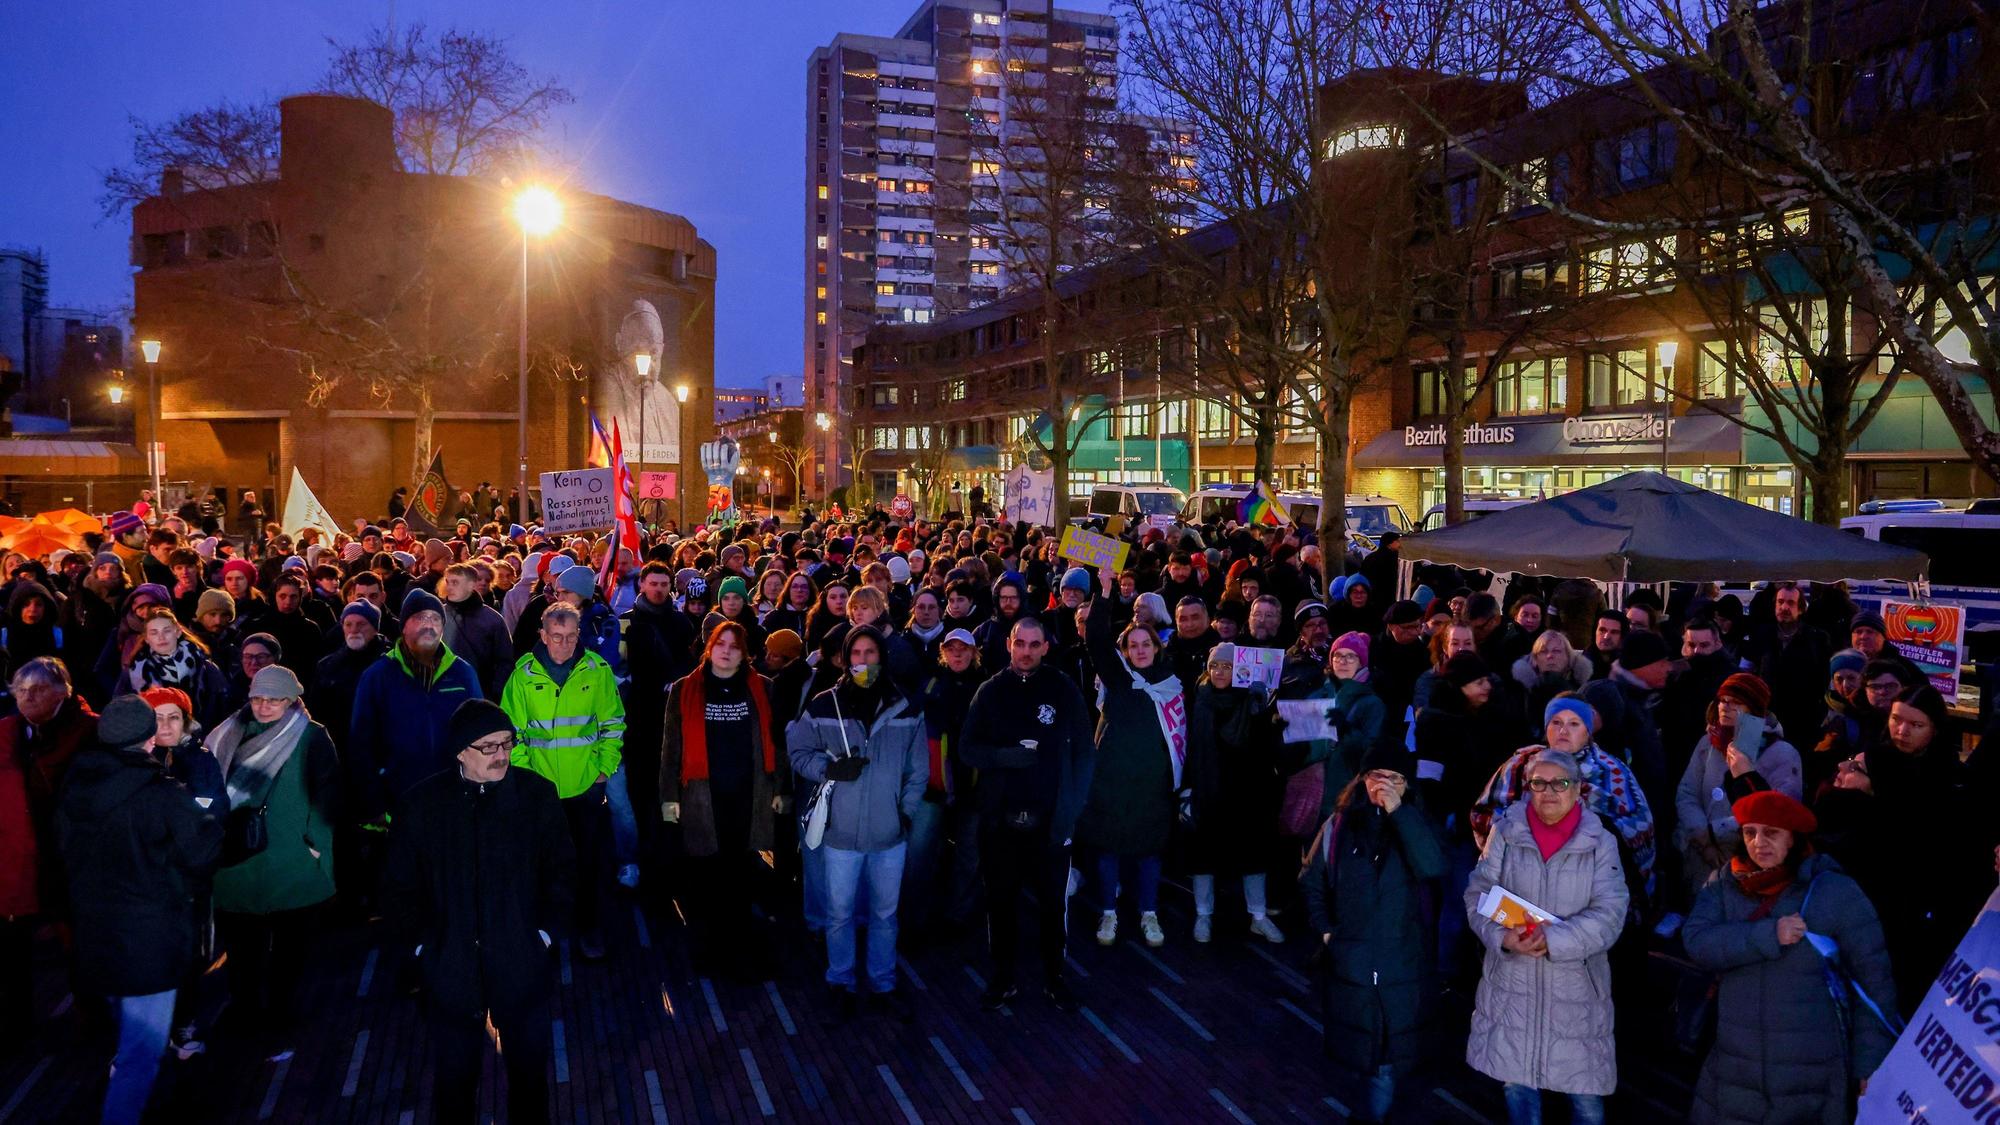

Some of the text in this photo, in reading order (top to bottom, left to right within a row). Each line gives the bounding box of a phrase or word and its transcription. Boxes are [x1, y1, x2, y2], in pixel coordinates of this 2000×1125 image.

[1405, 423, 1515, 446] Bezirkathaus
[652, 449, 676, 459] ERDEN
[553, 471, 582, 489] Kein
[547, 495, 609, 510] Rassismus
[1891, 641, 1943, 657] HORWEILER
[1899, 649, 1952, 667] LEIBT BUNT
